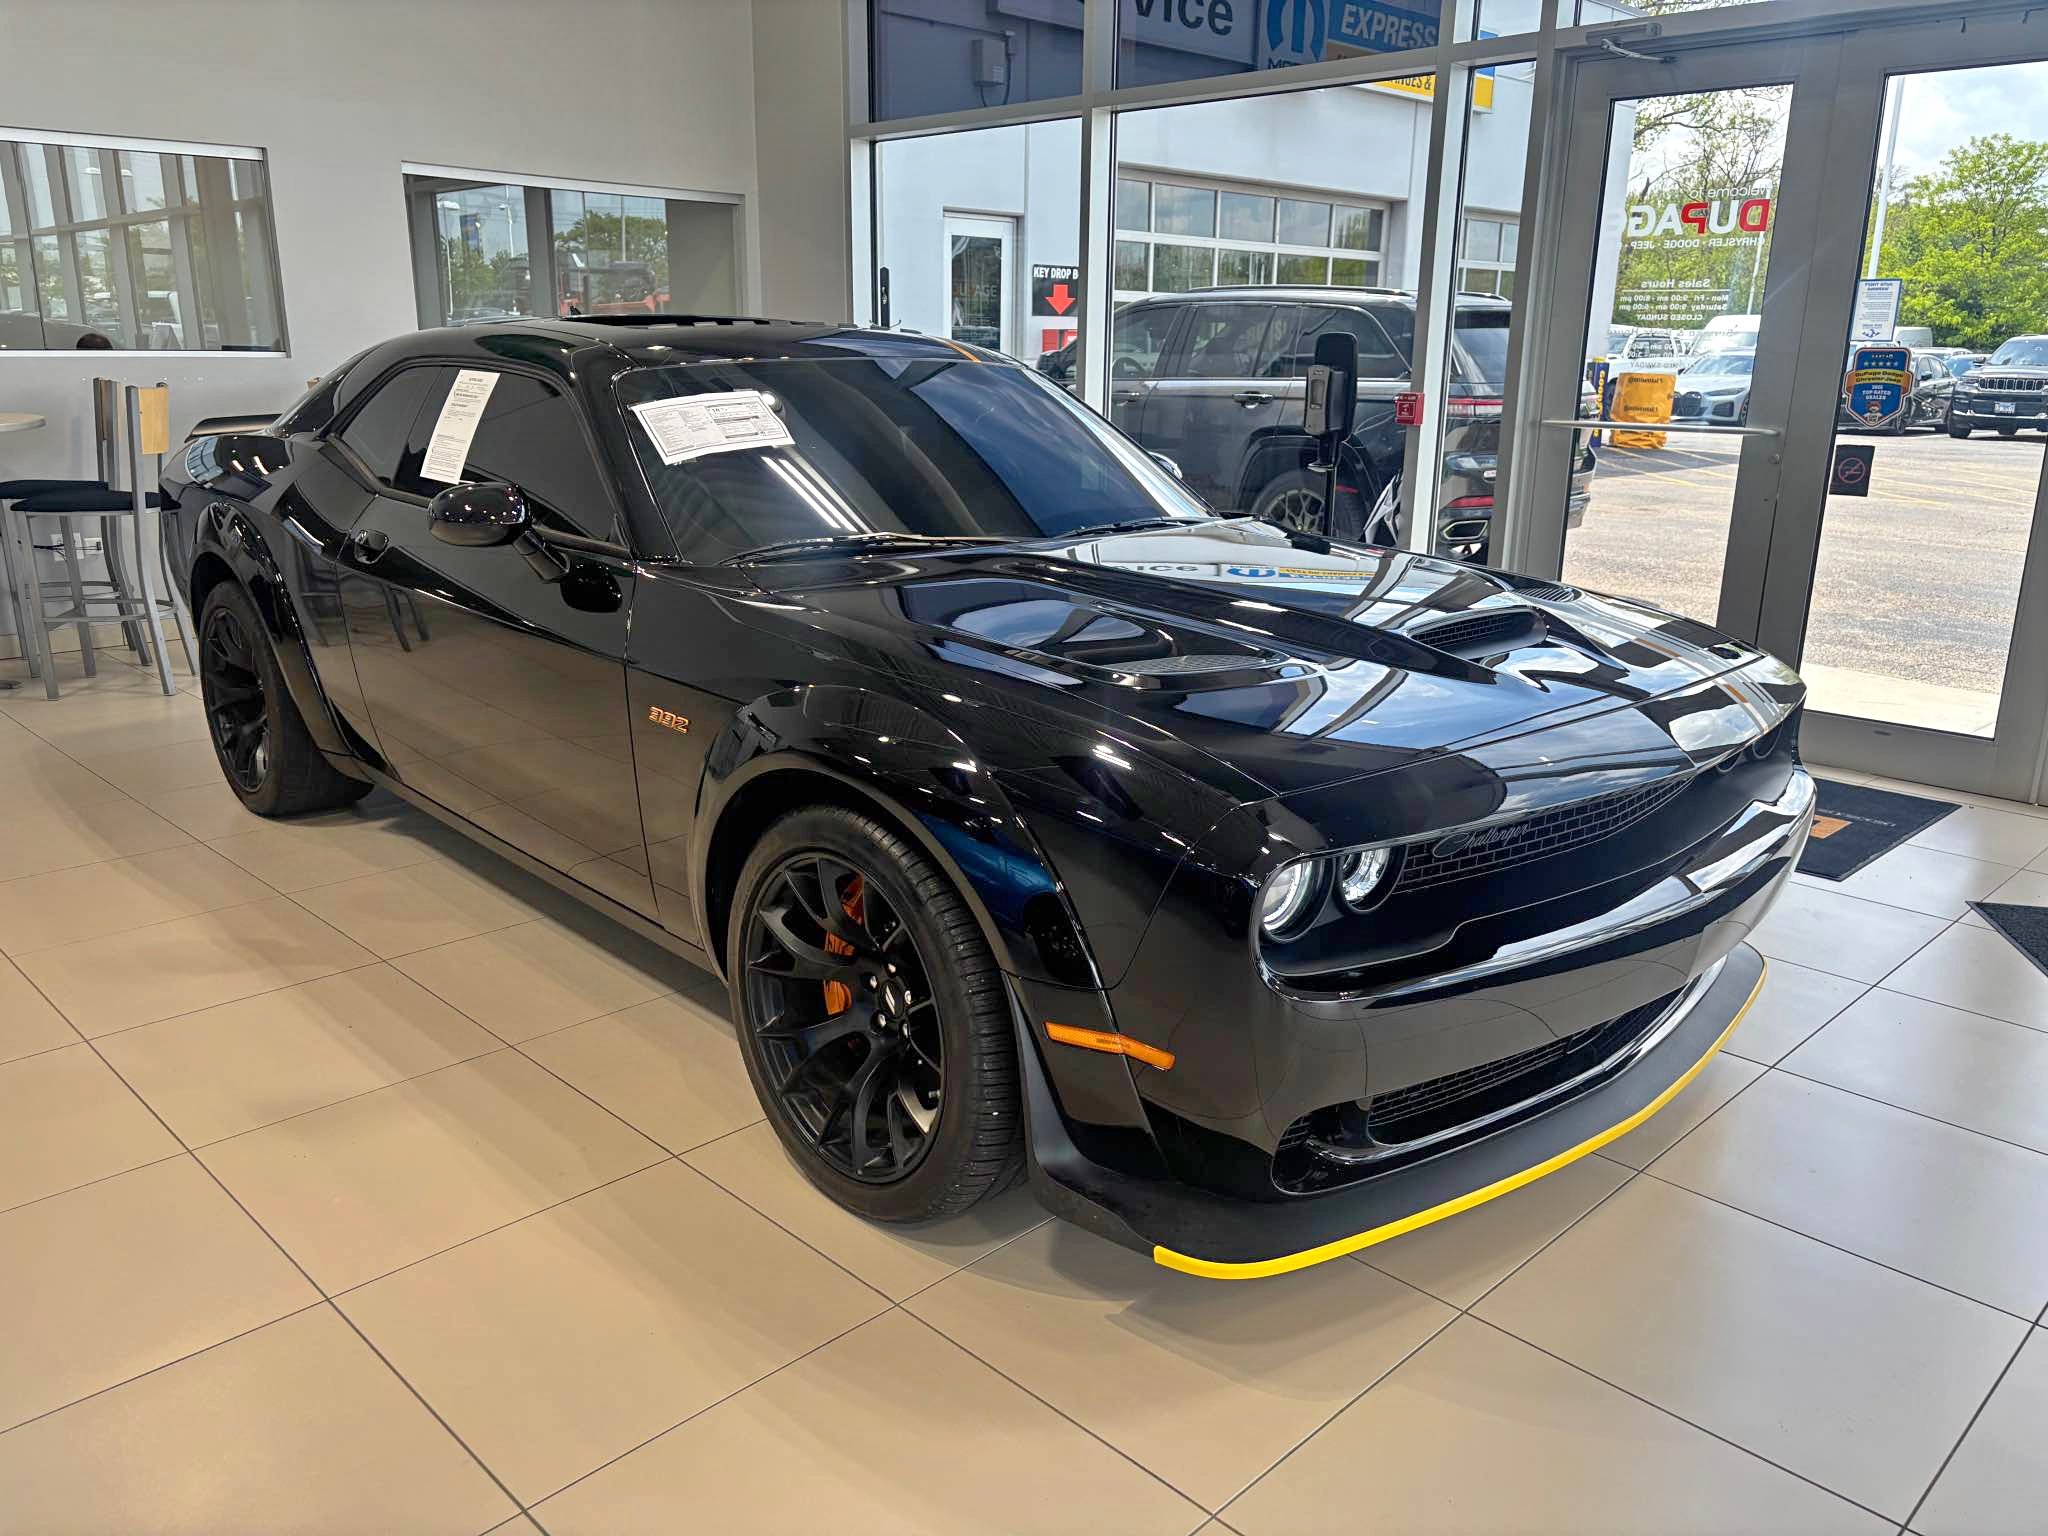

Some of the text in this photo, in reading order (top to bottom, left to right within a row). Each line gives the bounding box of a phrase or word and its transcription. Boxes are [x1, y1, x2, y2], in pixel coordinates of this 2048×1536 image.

[1341, 4, 1438, 48] EXPRESS
[1424, 75, 1432, 90] &
[1033, 267, 1050, 279] KEY
[1050, 268, 1071, 279] DROP
[1432, 823, 1529, 858] Challenger
